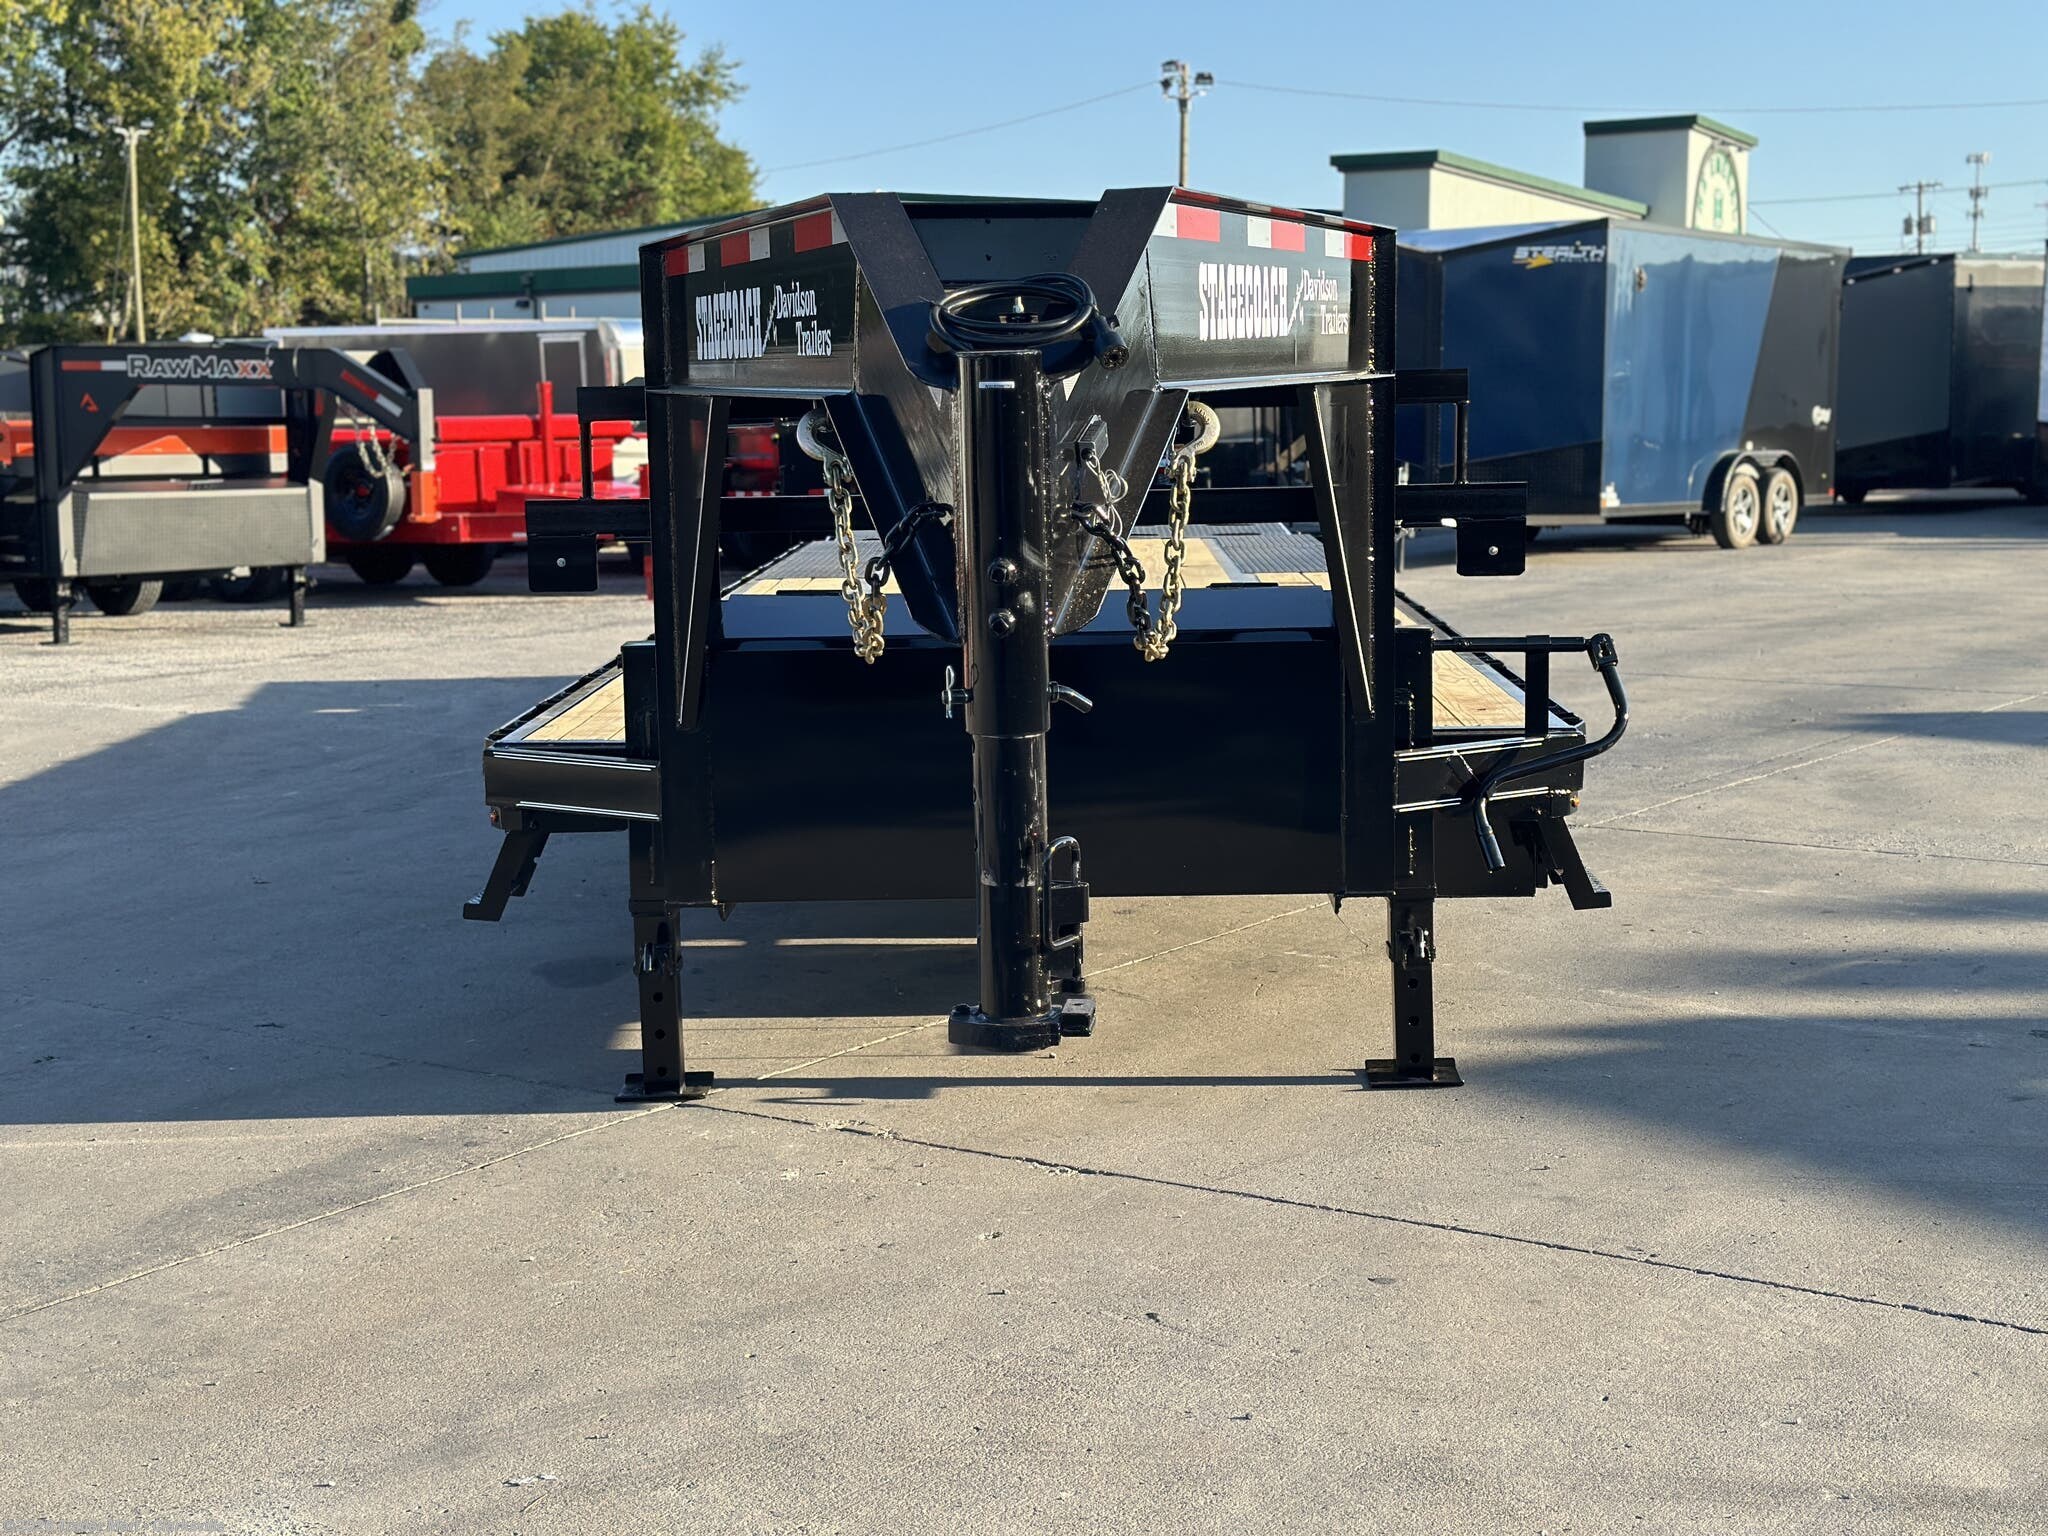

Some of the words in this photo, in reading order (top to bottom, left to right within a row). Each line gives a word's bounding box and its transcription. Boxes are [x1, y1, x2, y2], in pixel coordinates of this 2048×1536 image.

[1513, 246, 1606, 261] STEALTH
[775, 281, 817, 319] Davidson
[1199, 261, 1288, 342] STAGECOACH
[1303, 267, 1338, 302] Davidson
[695, 287, 763, 361] STAGECOACH
[1320, 304, 1349, 335] Trailers
[795, 320, 832, 357] Trailers
